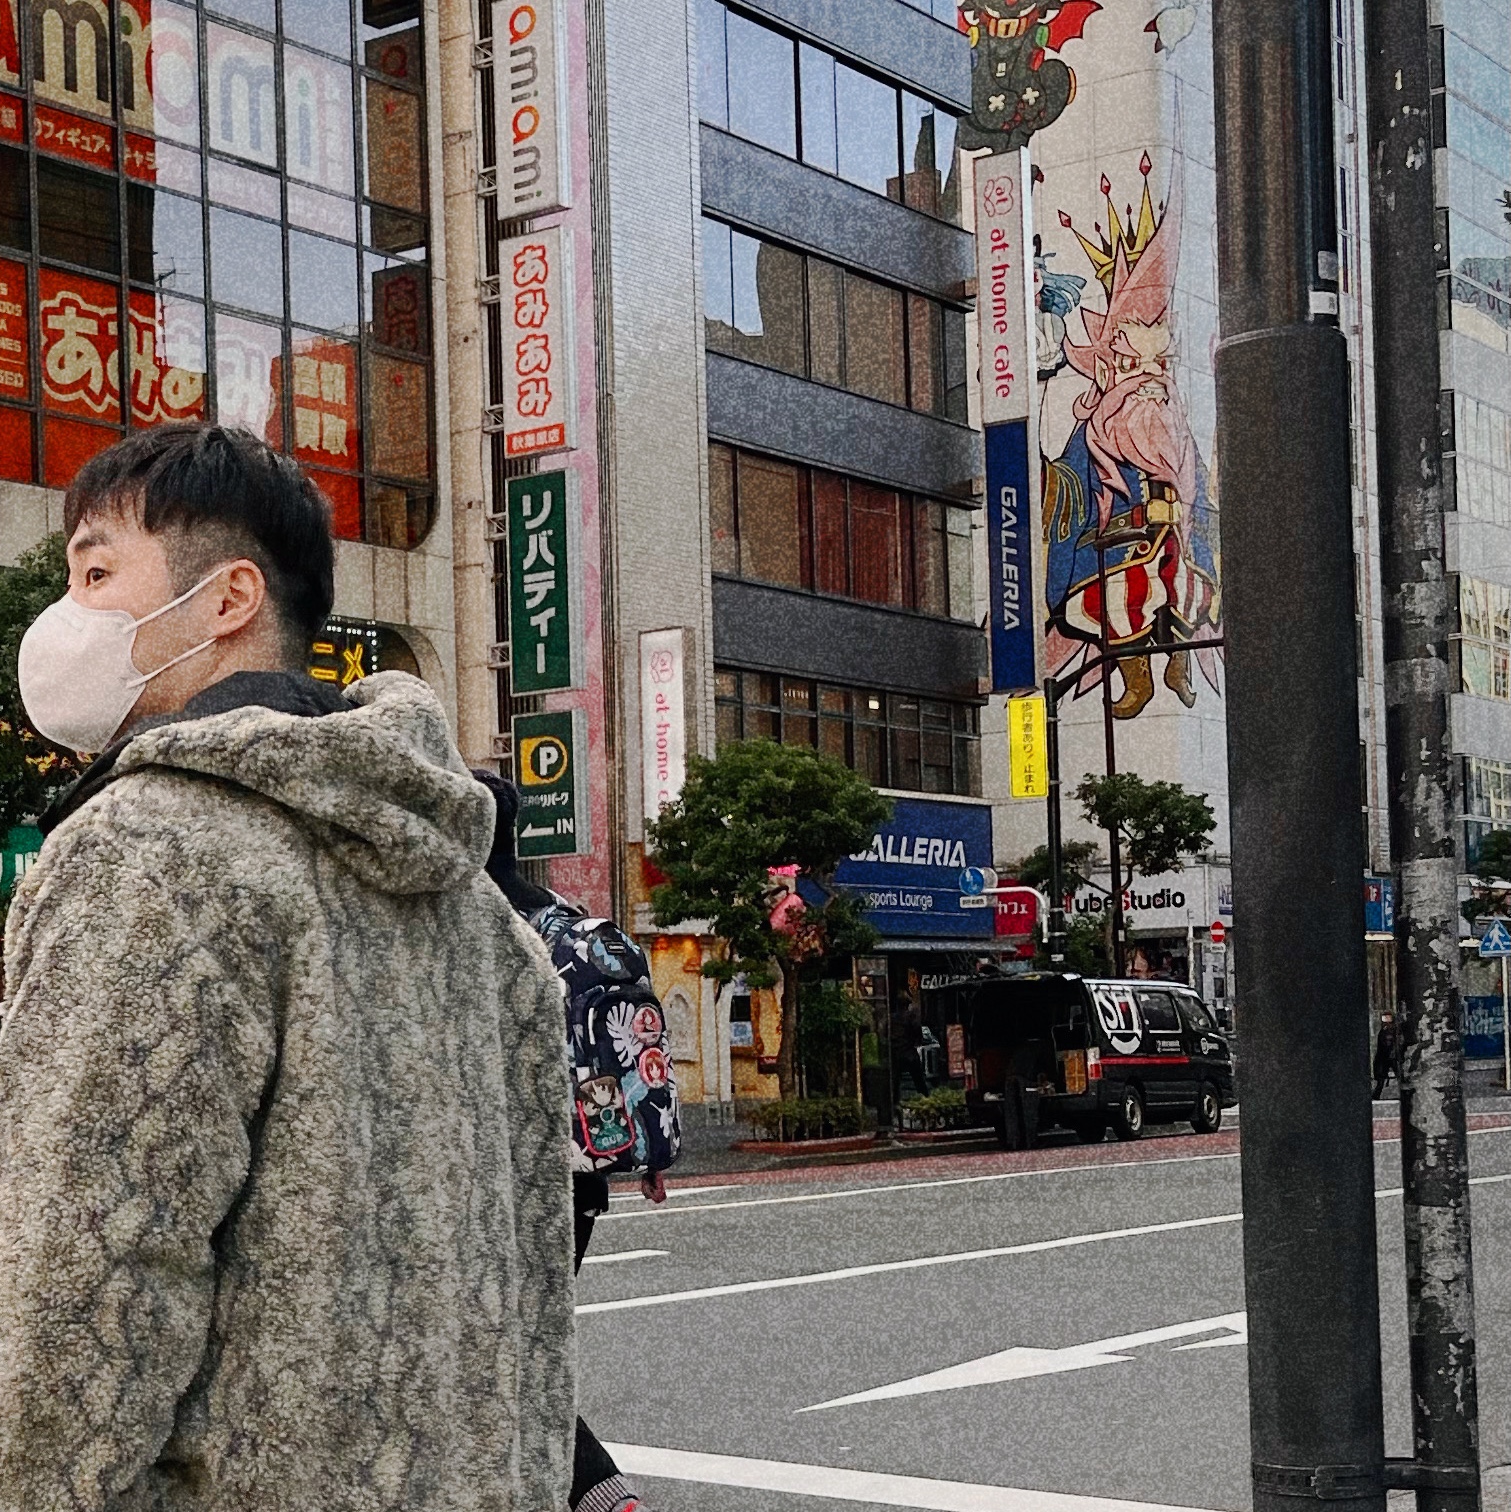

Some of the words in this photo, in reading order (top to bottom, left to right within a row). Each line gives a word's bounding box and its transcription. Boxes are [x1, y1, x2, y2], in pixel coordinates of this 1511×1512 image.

[513, 245, 552, 417] あみあみ
[522, 490, 556, 674] リバティー
[1000, 485, 1021, 632] GALLERIA
[556, 817, 574, 835] IN
[898, 890, 934, 911] Lounge
